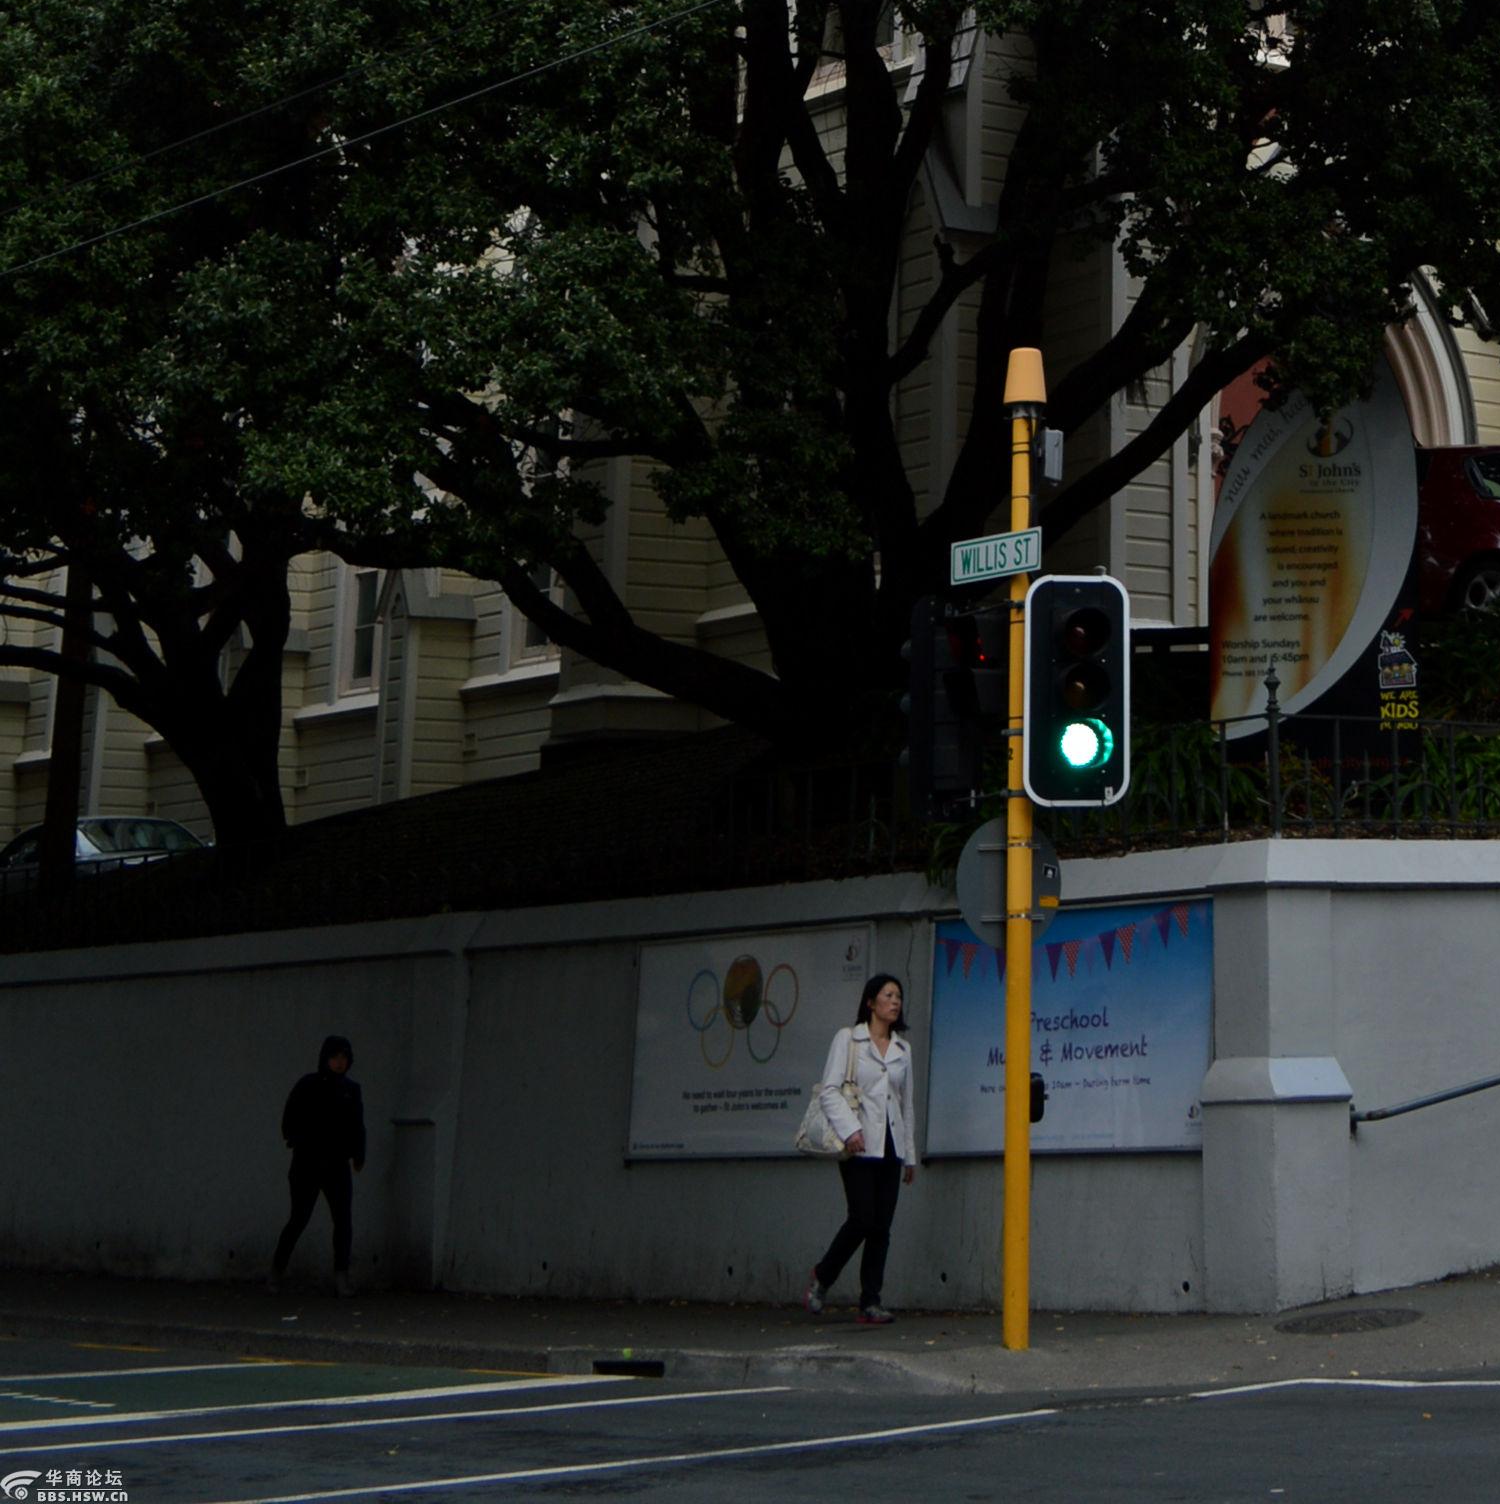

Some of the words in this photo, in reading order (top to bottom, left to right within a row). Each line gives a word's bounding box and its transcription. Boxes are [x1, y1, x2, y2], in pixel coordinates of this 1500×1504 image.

[1310, 510, 1341, 520] church
[1269, 528, 1295, 537] where
[1297, 527, 1335, 537] tradition
[1299, 544, 1338, 555] creativity
[961, 542, 1007, 575] WILLIS
[1013, 537, 1032, 566] ST
[1286, 561, 1339, 572] encouraged
[1272, 578, 1289, 587] and
[1291, 580, 1307, 589] you
[1309, 577, 1326, 587] and
[1263, 597, 1282, 607] your
[1222, 639, 1260, 650] Worship
[1261, 638, 1301, 650] Sundays
[1223, 654, 1247, 664] 10am
[1249, 653, 1267, 664] and
[1380, 700, 1419, 720] KIDS
[1039, 1039, 1053, 1066] &
[1060, 1034, 1148, 1063] Movement
